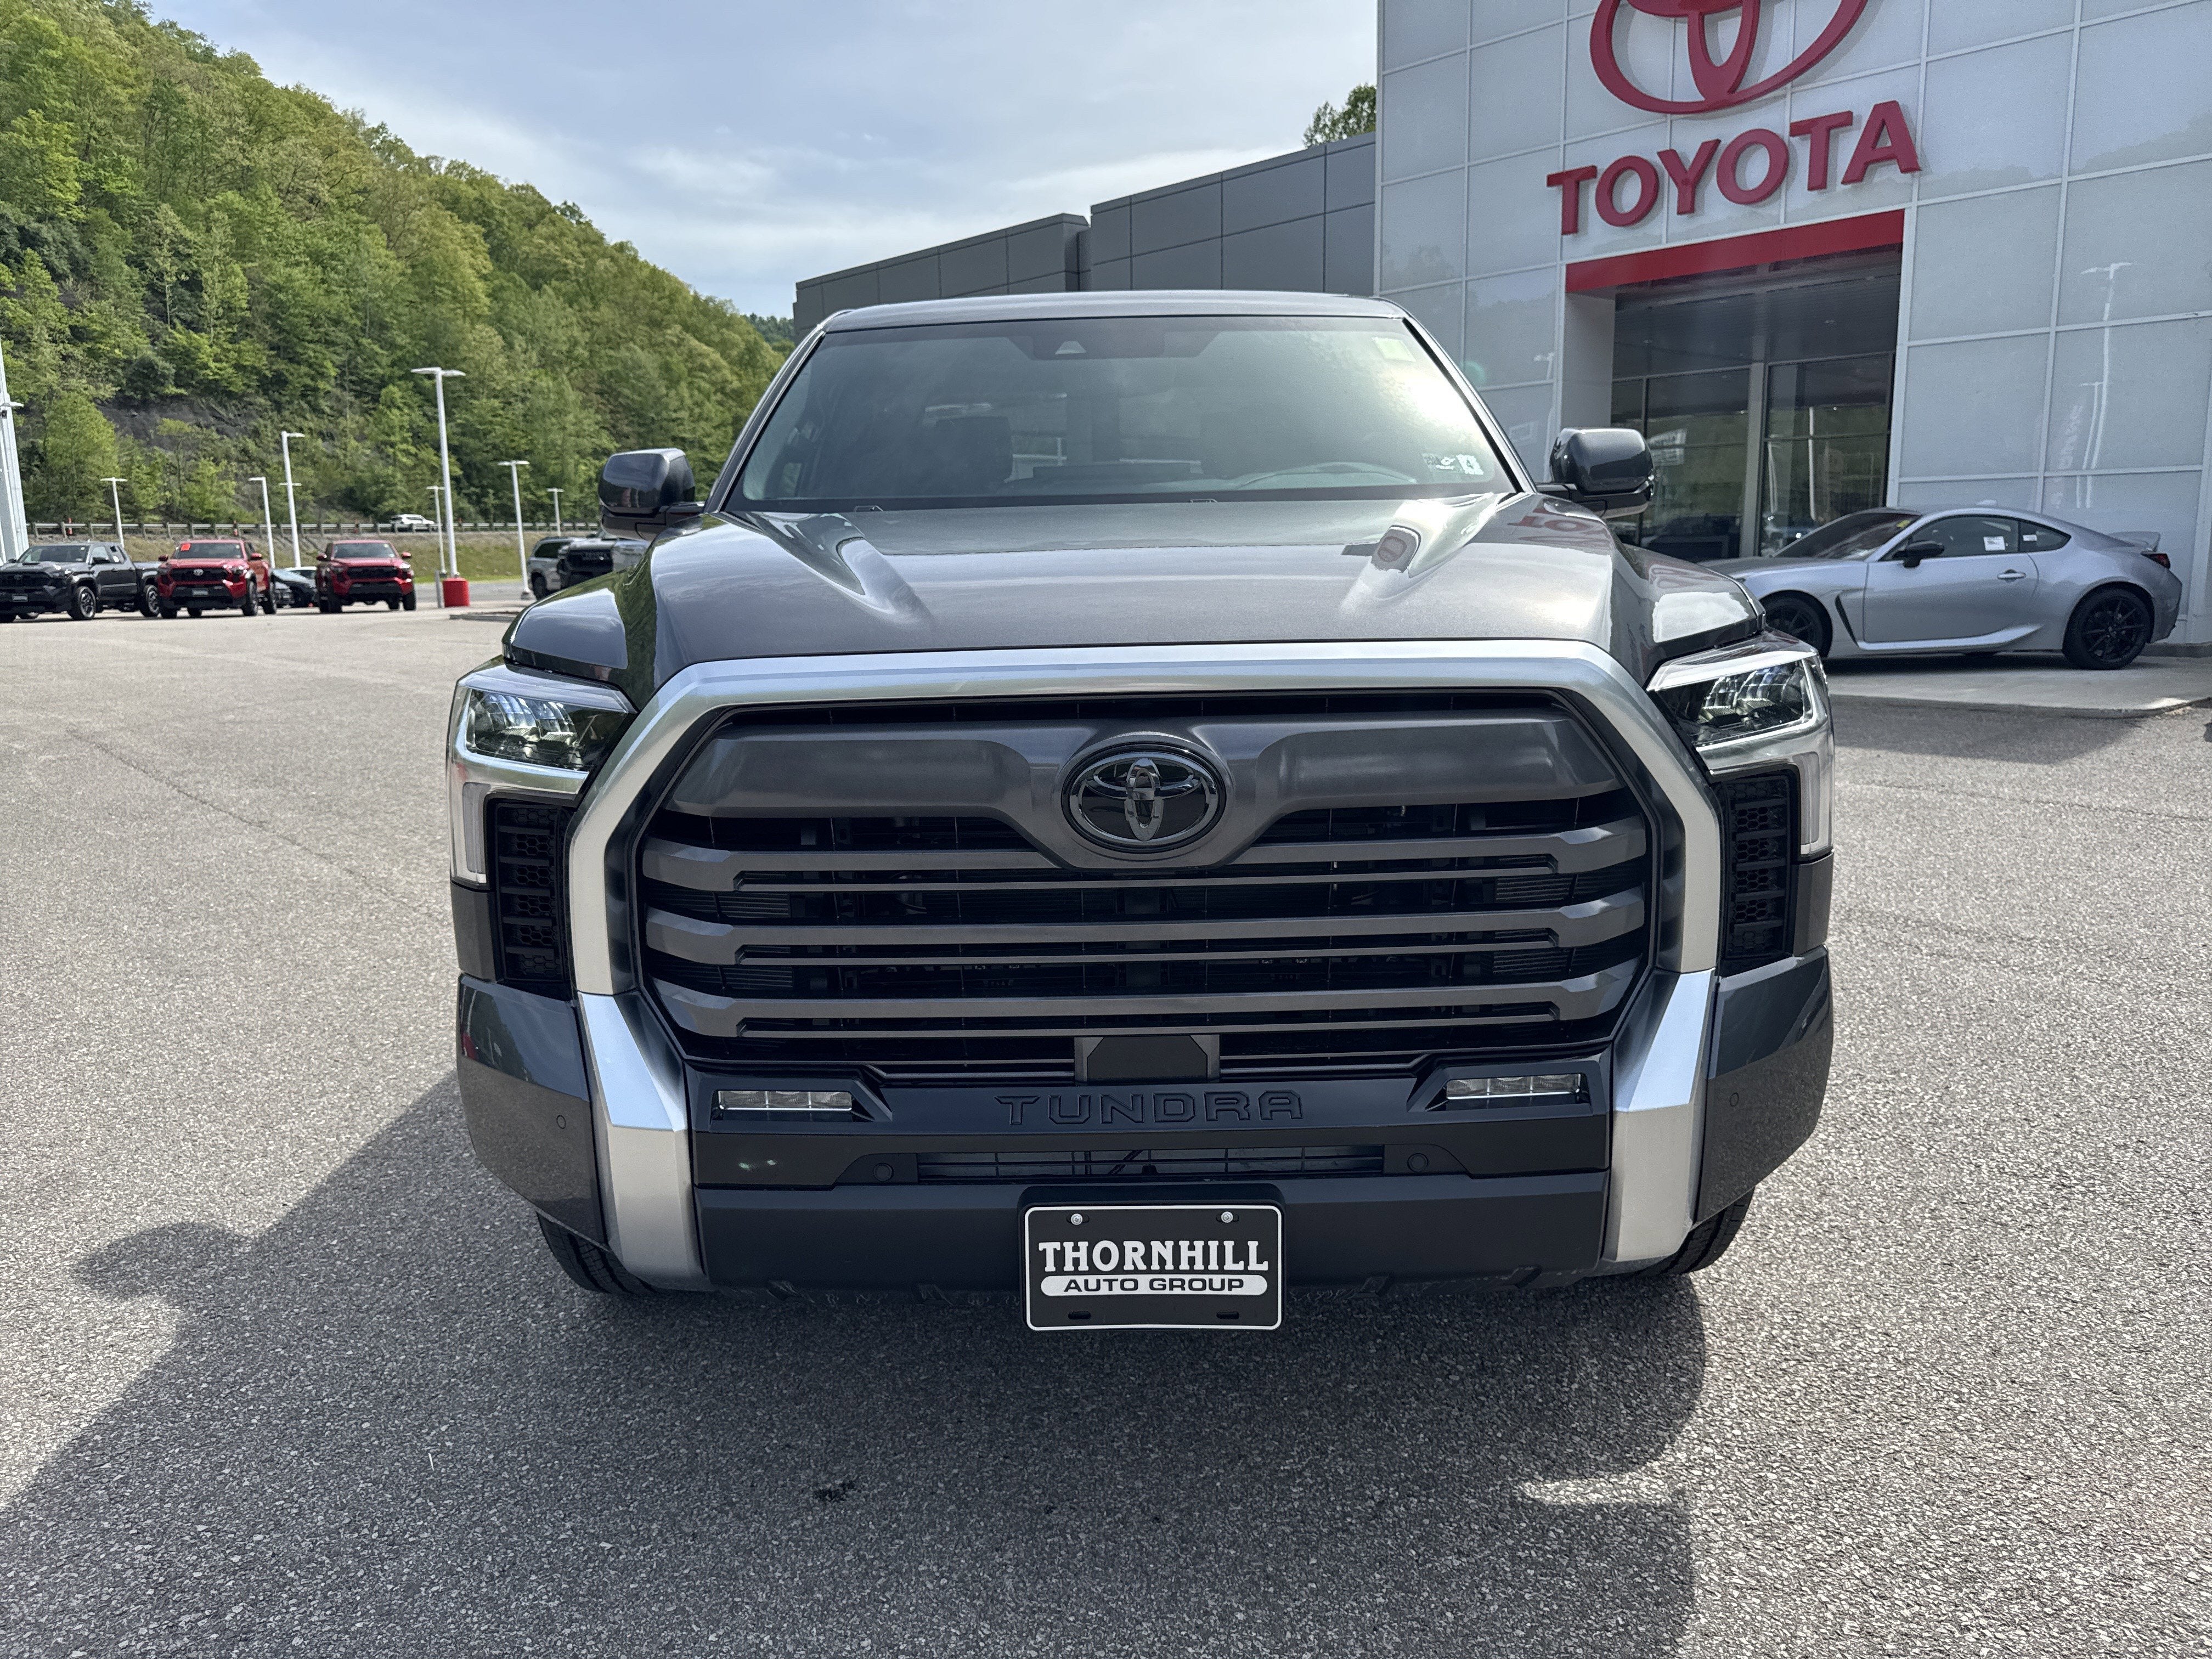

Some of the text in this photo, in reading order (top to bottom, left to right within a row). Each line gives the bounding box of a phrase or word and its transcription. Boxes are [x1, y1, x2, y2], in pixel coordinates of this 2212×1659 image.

[1547, 100, 1922, 235] TOYOTA
[994, 1090, 1303, 1125] TUNDRA
[1039, 1240, 1268, 1272] THORNHILL
[1064, 1278, 1244, 1292] AUTO GROUP
